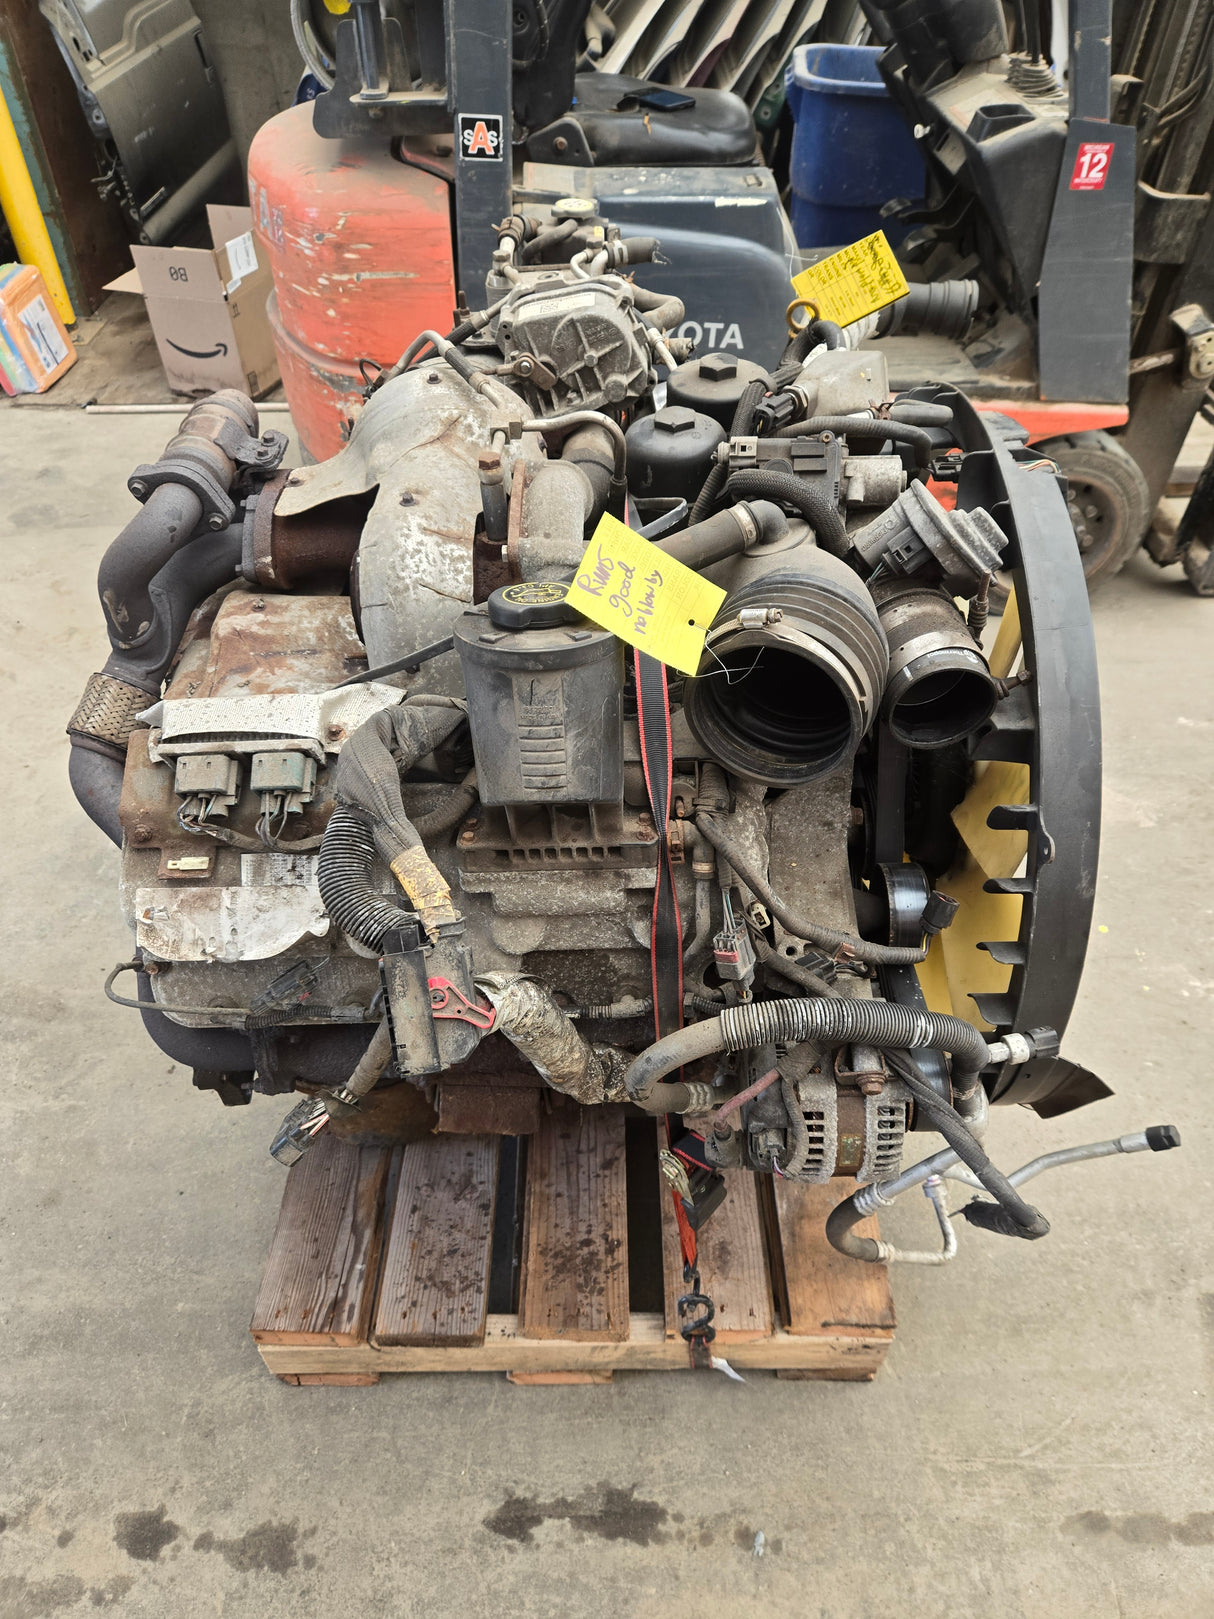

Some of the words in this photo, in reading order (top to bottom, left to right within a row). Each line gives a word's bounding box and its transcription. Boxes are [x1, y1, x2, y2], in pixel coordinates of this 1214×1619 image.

[1080, 152, 1107, 178] 12
[665, 321, 744, 349] OTA
[609, 561, 635, 617] good
